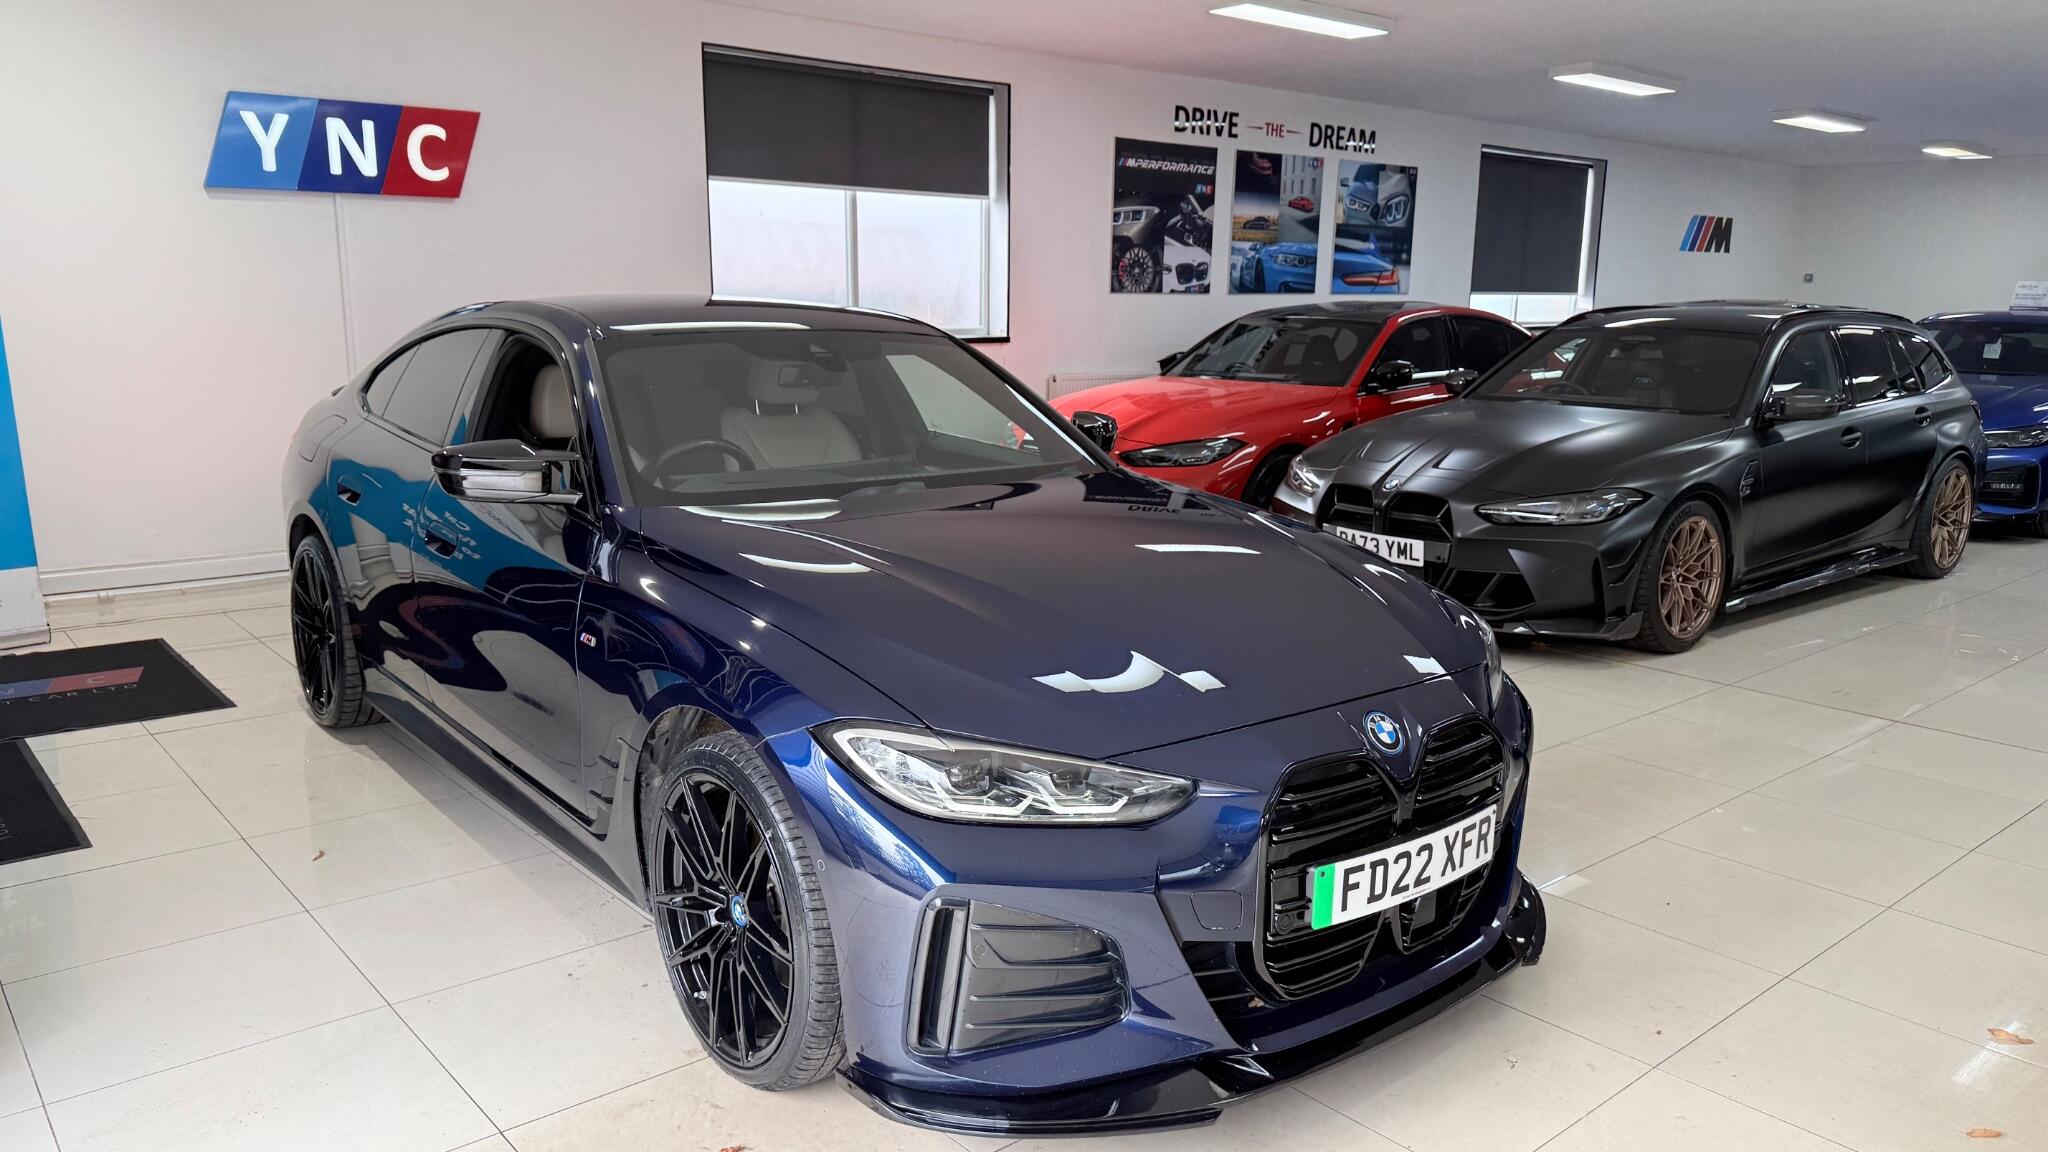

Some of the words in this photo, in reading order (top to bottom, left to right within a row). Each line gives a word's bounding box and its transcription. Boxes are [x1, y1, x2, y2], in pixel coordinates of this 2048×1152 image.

[240, 110, 449, 182] YNC
[1174, 105, 1239, 138] DRIVE
[1265, 122, 1285, 138] THE
[1309, 122, 1376, 154] DREAM
[1385, 538, 1420, 562] YML
[1341, 843, 1433, 912] FD22
[1441, 815, 1492, 877] XFR
